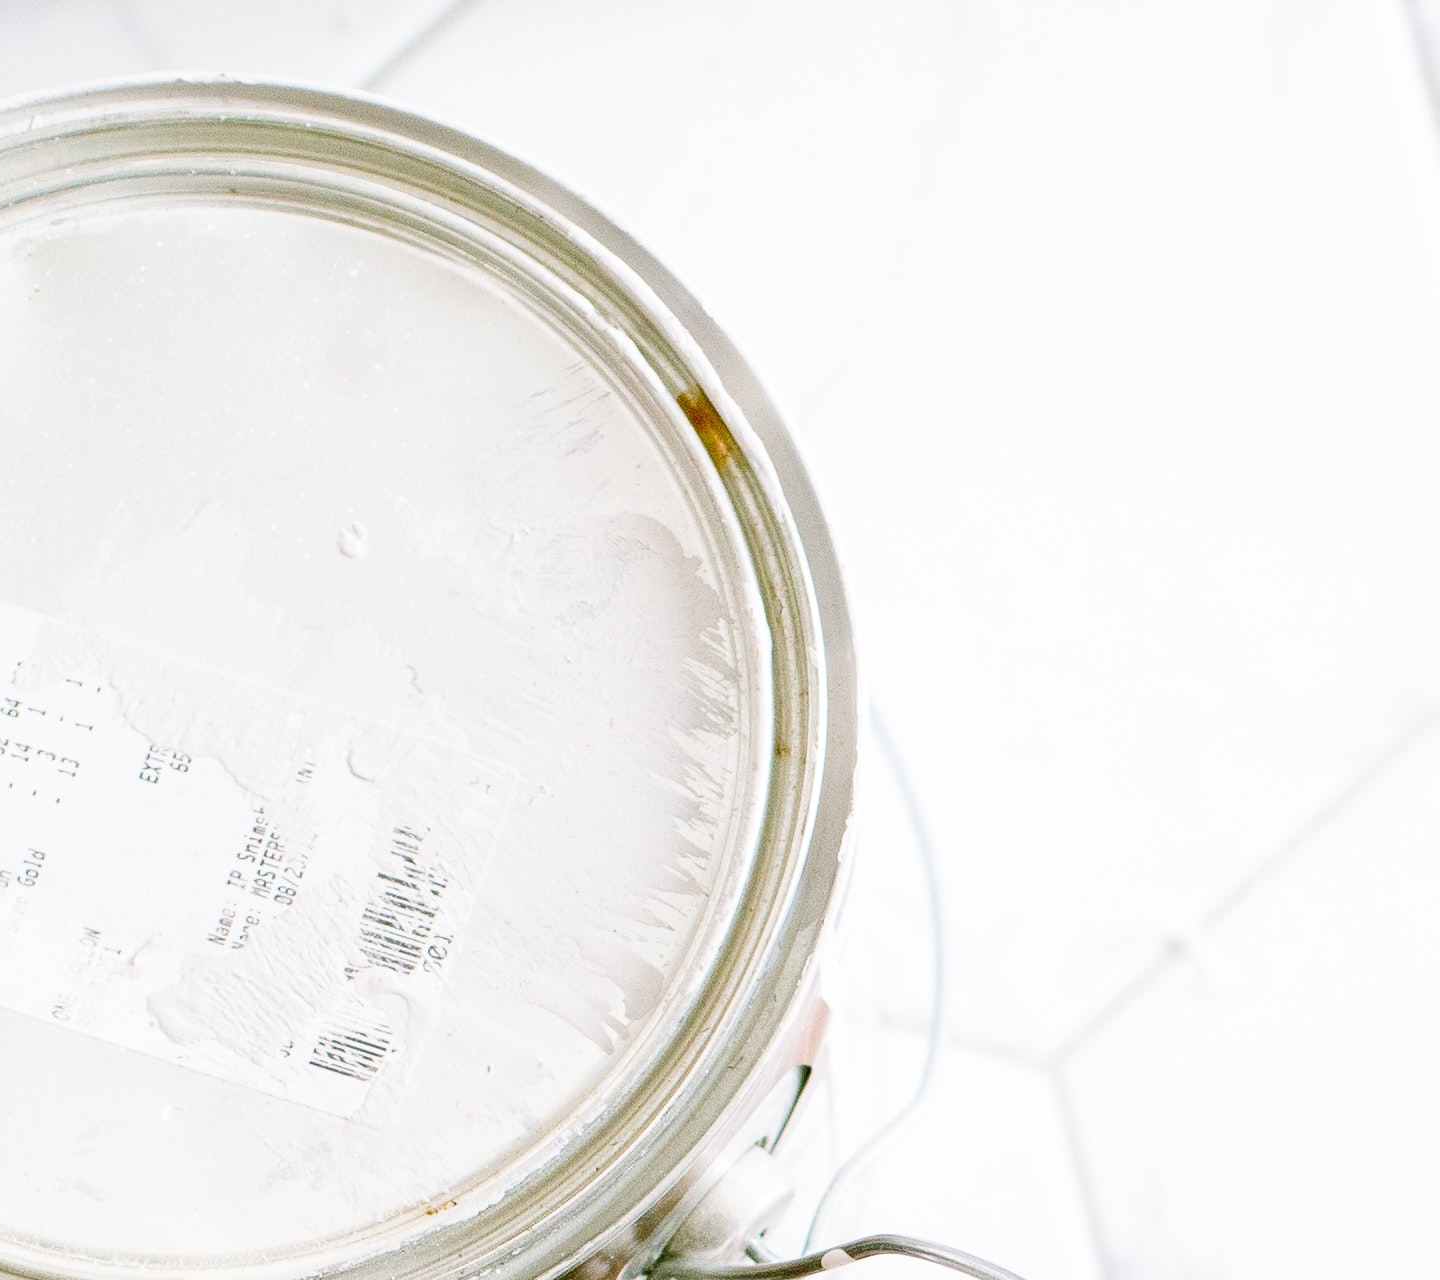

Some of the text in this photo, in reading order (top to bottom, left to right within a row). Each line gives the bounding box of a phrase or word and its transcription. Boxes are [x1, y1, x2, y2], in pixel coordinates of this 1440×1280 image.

[10, 741, 32, 763] 14
[35, 748, 57, 761] 3
[15, 847, 46, 887] Gold
[56, 756, 80, 778] 13
[225, 869, 245, 889] IP
